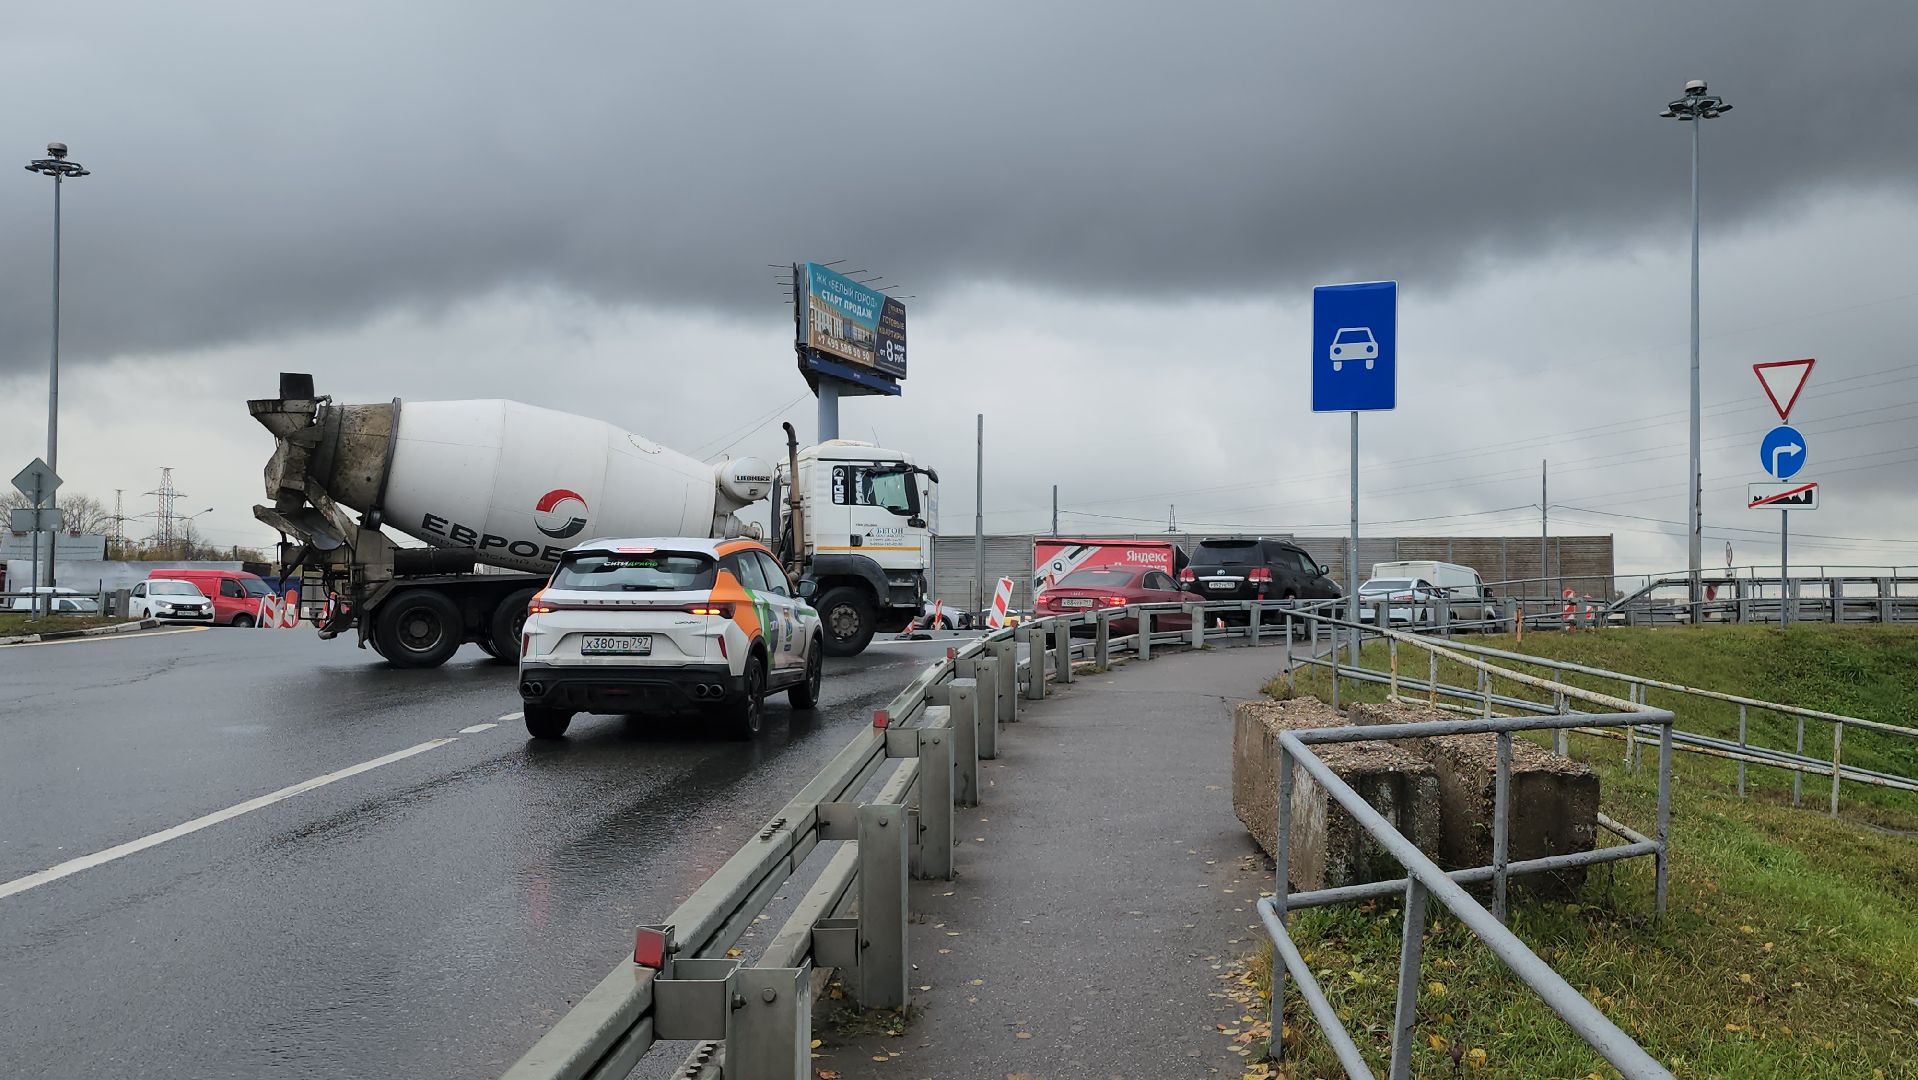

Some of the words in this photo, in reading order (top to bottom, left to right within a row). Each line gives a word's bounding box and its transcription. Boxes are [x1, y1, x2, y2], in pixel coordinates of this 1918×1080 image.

[821, 289, 843, 307] СТАРТ
[843, 299, 873, 319] ПРОДАЖ
[886, 339, 894, 362] 8
[1126, 550, 1168, 563] Яндекс
